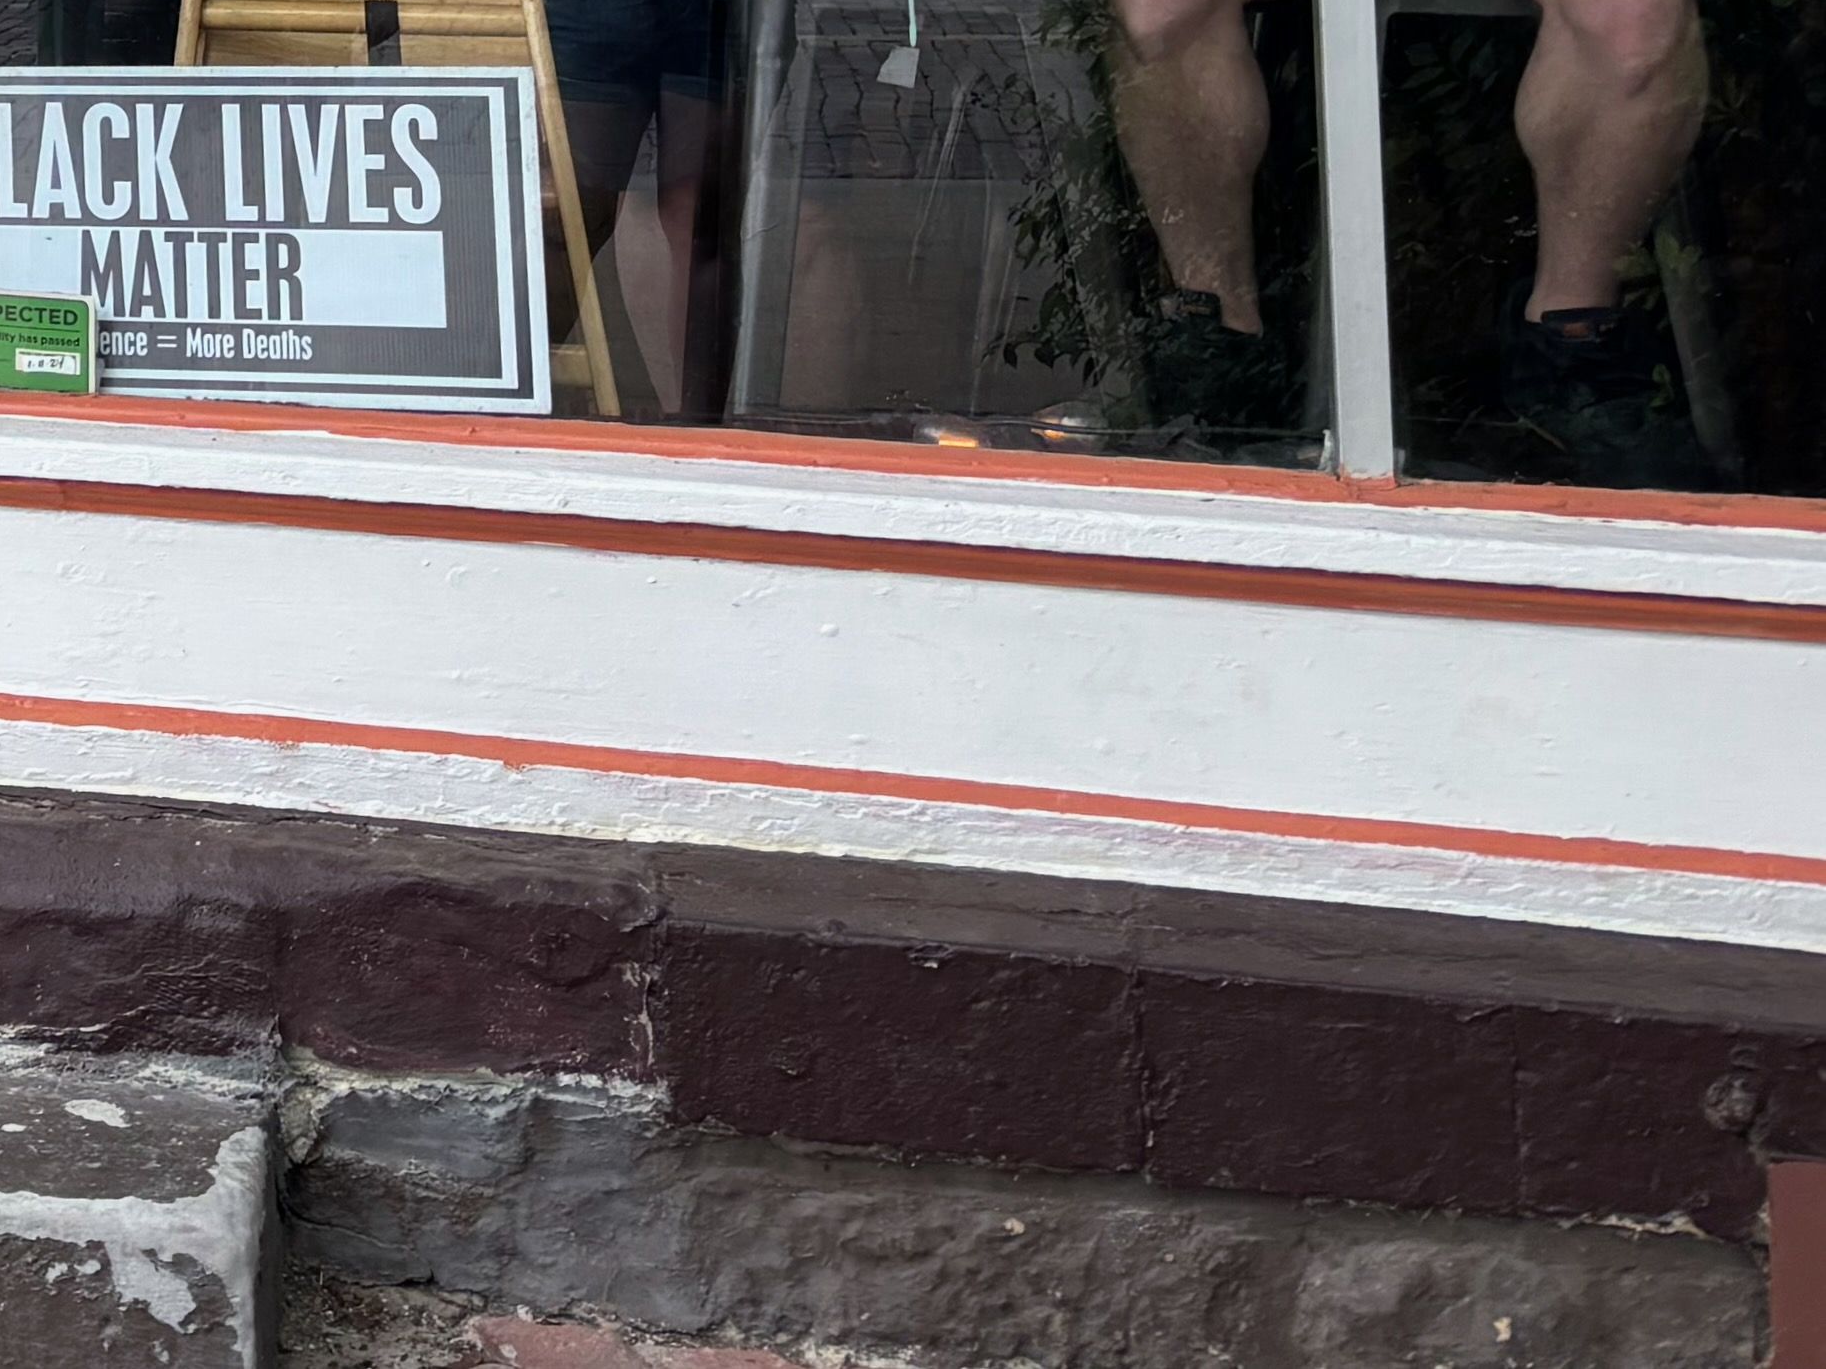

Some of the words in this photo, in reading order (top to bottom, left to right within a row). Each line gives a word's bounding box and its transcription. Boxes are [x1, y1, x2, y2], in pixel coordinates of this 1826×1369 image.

[222, 103, 442, 224] LIVES
[79, 229, 305, 322] MATTER
[18, 333, 38, 344] has
[40, 337, 80, 347] passed
[98, 329, 148, 357] ence
[186, 327, 235, 359] More
[242, 328, 313, 361] Deaths
